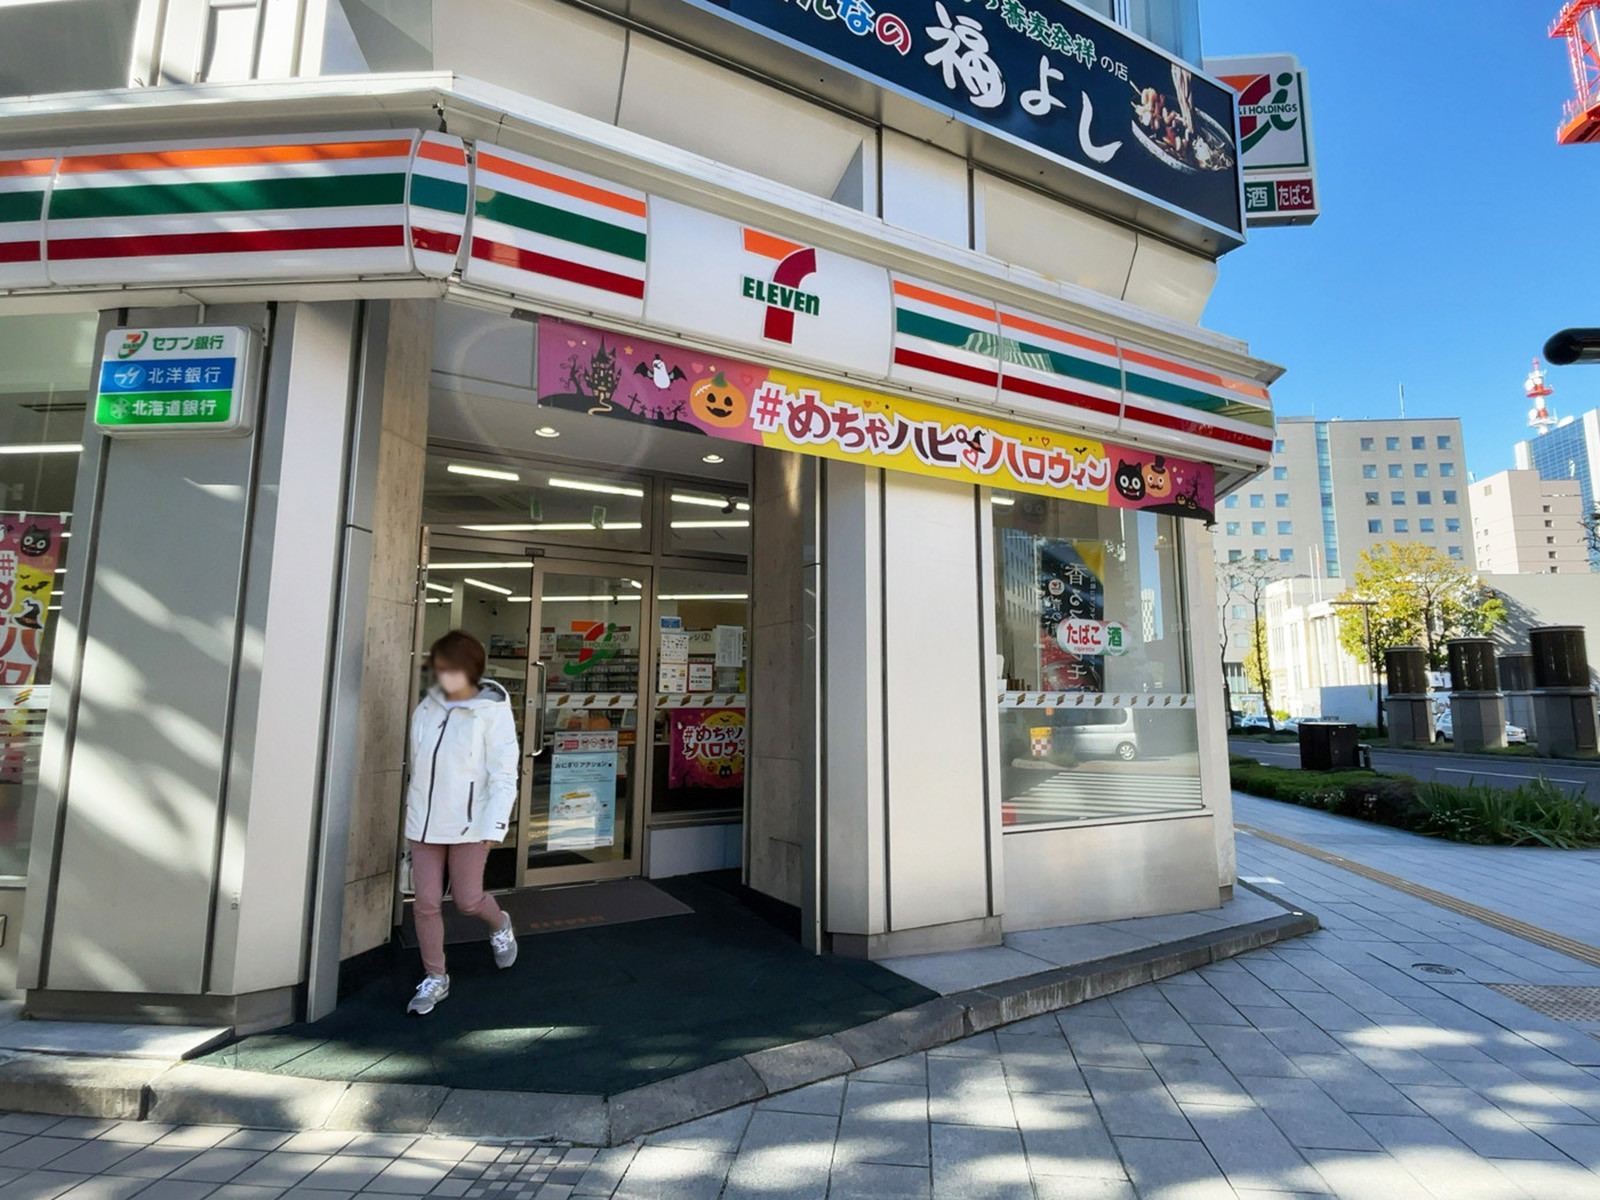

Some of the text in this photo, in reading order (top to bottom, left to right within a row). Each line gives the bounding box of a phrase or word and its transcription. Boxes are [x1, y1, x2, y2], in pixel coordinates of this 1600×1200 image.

[924, 1, 1122, 164] 福よし
[1249, 103, 1298, 115] HOLDINGS
[1246, 186, 1269, 208] 酒
[1278, 184, 1313, 206] たばこ
[152, 335, 225, 351] セブン銀行
[148, 366, 221, 384] 北洋銀行
[132, 399, 217, 417] 北海道銀行
[1066, 623, 1101, 645] たばこ
[1108, 626, 1122, 647] 酒
